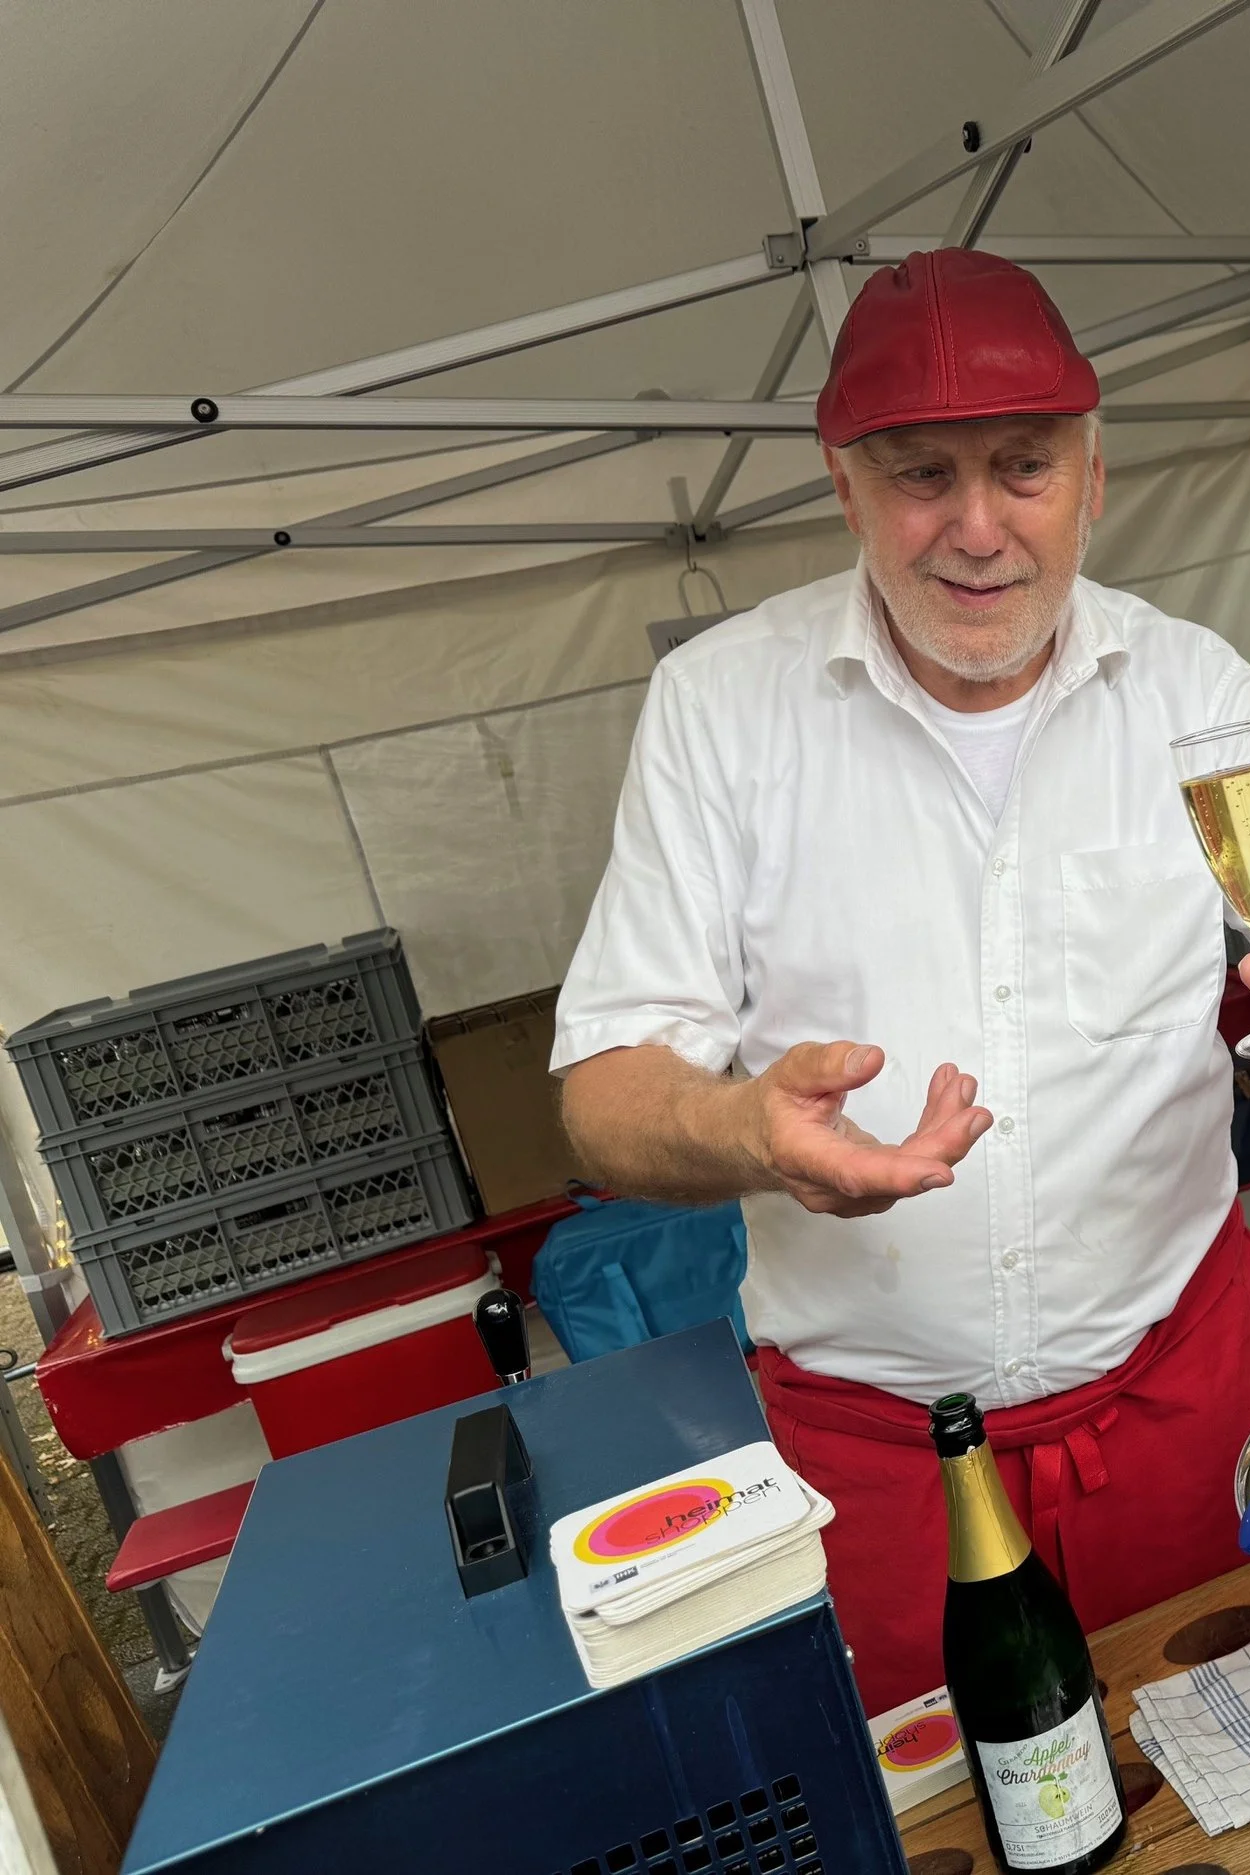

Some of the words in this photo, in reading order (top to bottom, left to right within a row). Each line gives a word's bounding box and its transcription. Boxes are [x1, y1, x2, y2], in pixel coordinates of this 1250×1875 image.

[643, 1483, 782, 1546] shoppen
[665, 1476, 778, 1528] heimat
[996, 1740, 1091, 1786] Chardonnay
[1034, 1803, 1093, 1834] SCHAUMWEIN
